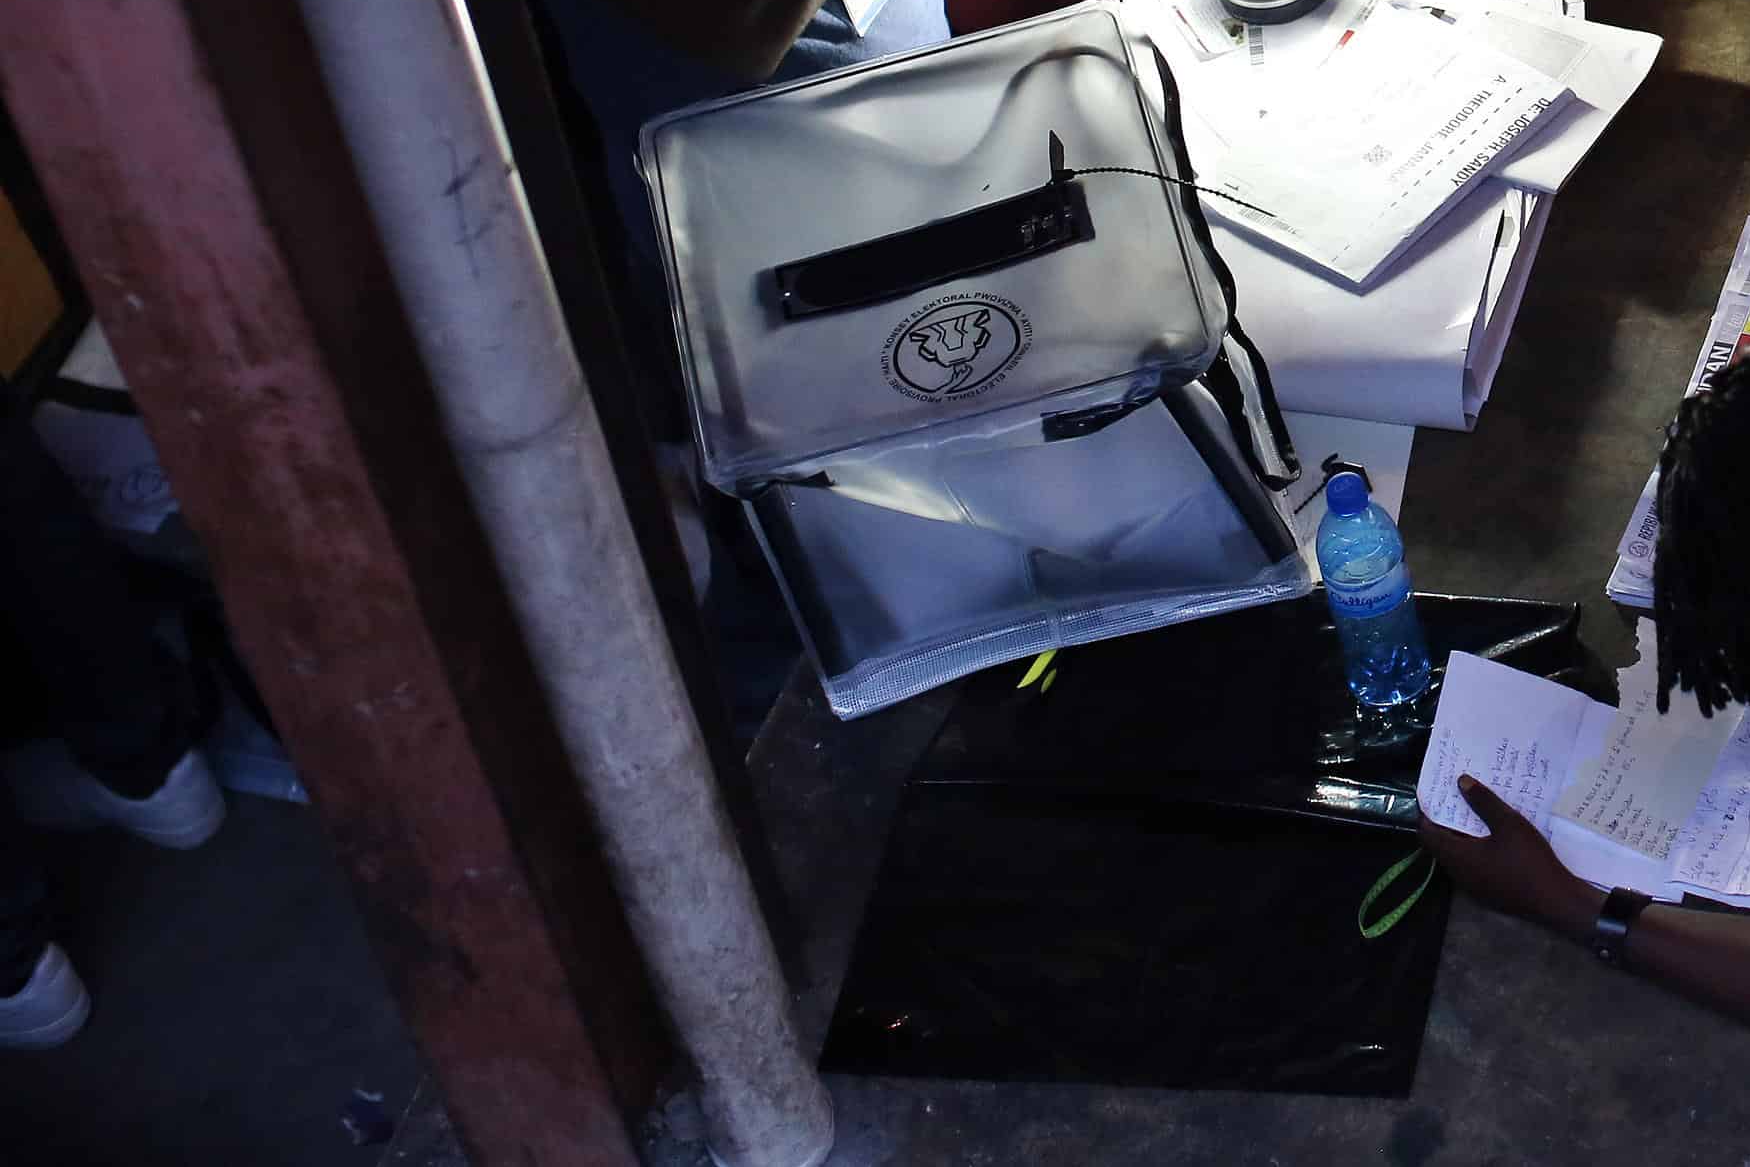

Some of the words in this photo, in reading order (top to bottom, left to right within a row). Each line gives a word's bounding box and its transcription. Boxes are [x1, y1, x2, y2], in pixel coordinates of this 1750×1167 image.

[1484, 113, 1530, 152] JOSEPH,
[1450, 153, 1490, 186] SANDY
[884, 317, 910, 349] KONSEY
[911, 292, 971, 318] ELEKTORAL
